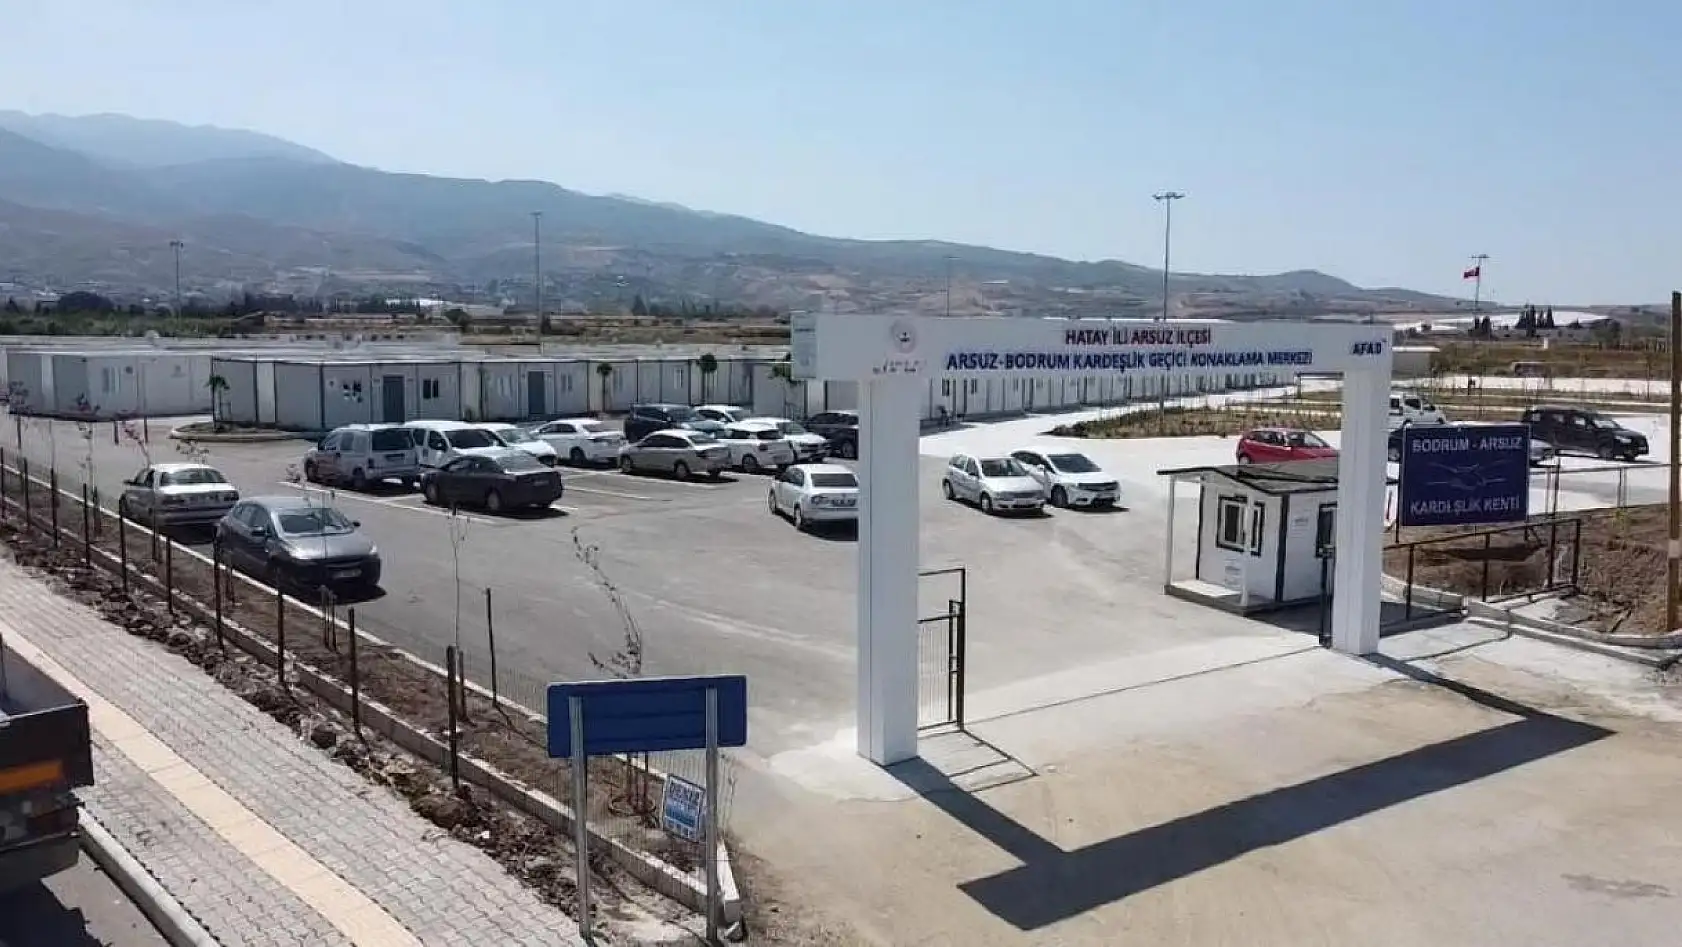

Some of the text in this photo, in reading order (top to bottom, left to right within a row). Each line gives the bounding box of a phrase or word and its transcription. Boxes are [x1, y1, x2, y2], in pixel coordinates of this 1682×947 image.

[1066, 329, 1108, 345] HATAY
[1131, 328, 1174, 345] ARSUZ
[1176, 327, 1211, 348] İLÇESİ
[1353, 341, 1382, 355] AFAD
[947, 352, 1070, 370] ARSUZ-BODRUM
[1073, 351, 1145, 373] KARDEŞLİK
[1149, 351, 1186, 370] GEÇİCİ
[1191, 351, 1263, 368] KONAKLAMA
[1267, 351, 1313, 366] MERKEZİ
[1412, 437, 1469, 453] BODRUM
[1480, 435, 1522, 451] ARSUZ
